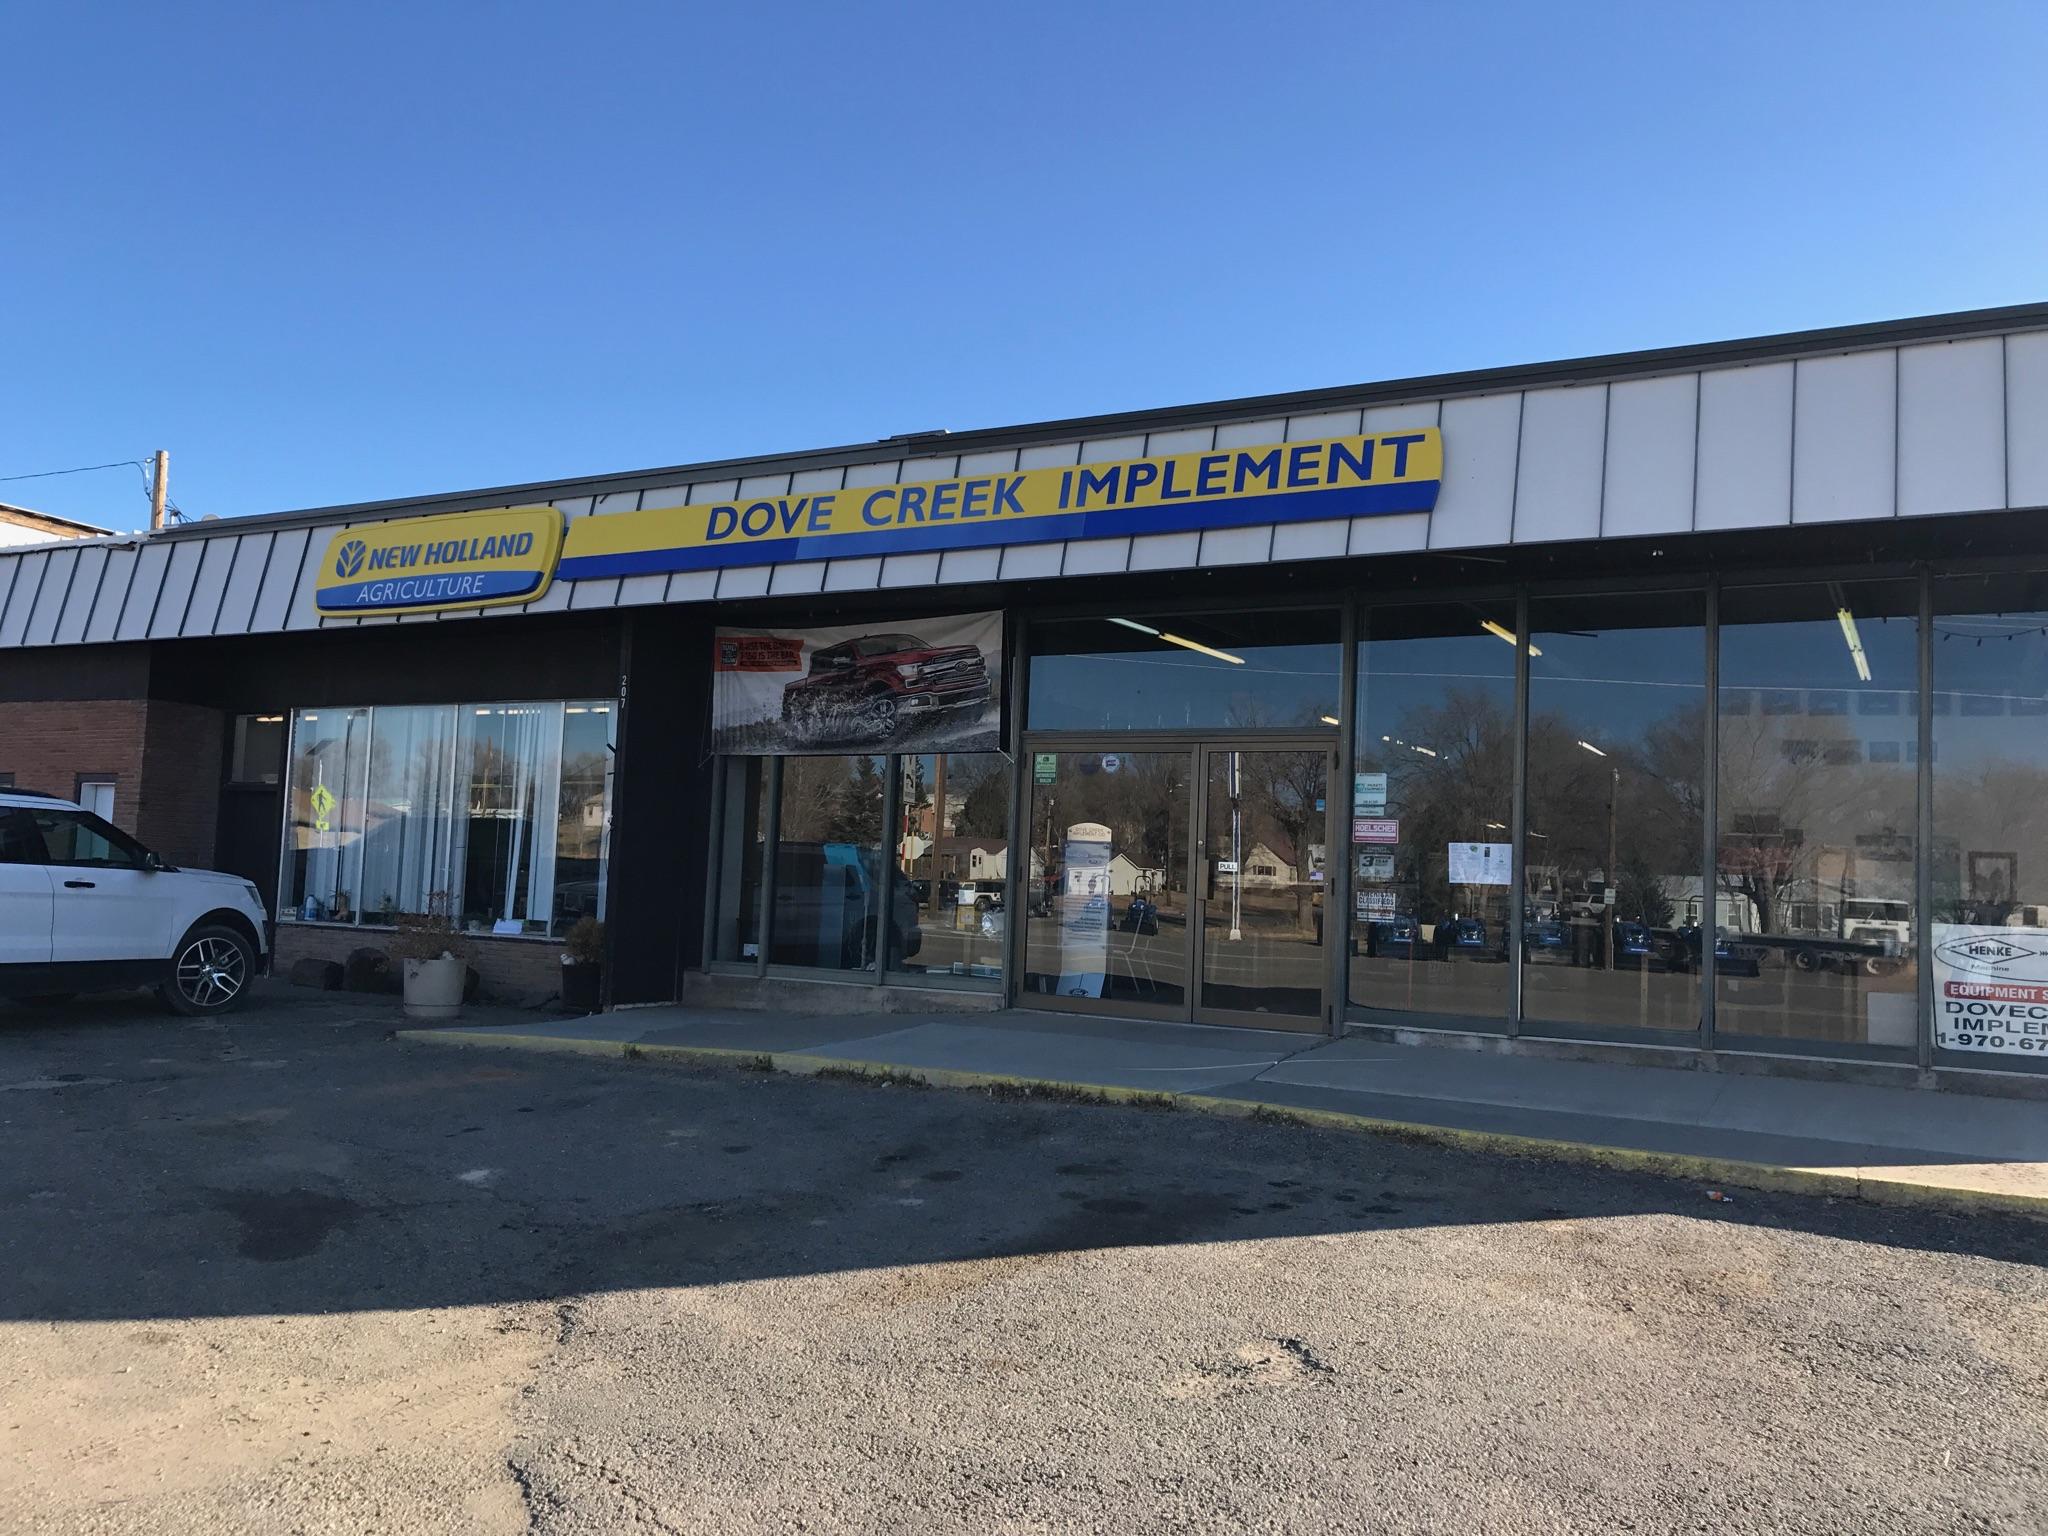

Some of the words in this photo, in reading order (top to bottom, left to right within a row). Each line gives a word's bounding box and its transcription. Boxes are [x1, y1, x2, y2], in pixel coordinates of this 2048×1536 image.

[706, 496, 835, 541] DOVE
[862, 476, 1025, 526] CREEK
[1058, 434, 1425, 509] IMPLEMENT
[368, 544, 422, 570] NEW
[424, 532, 533, 566] HOLLAND
[356, 575, 485, 603] AGRICULTURE
[1355, 824, 1396, 833] HOELSCHER
[1362, 856, 1374, 867] 3
[1969, 945, 2012, 957] HENKE
[1950, 984, 2037, 1000] EQUIPMENT
